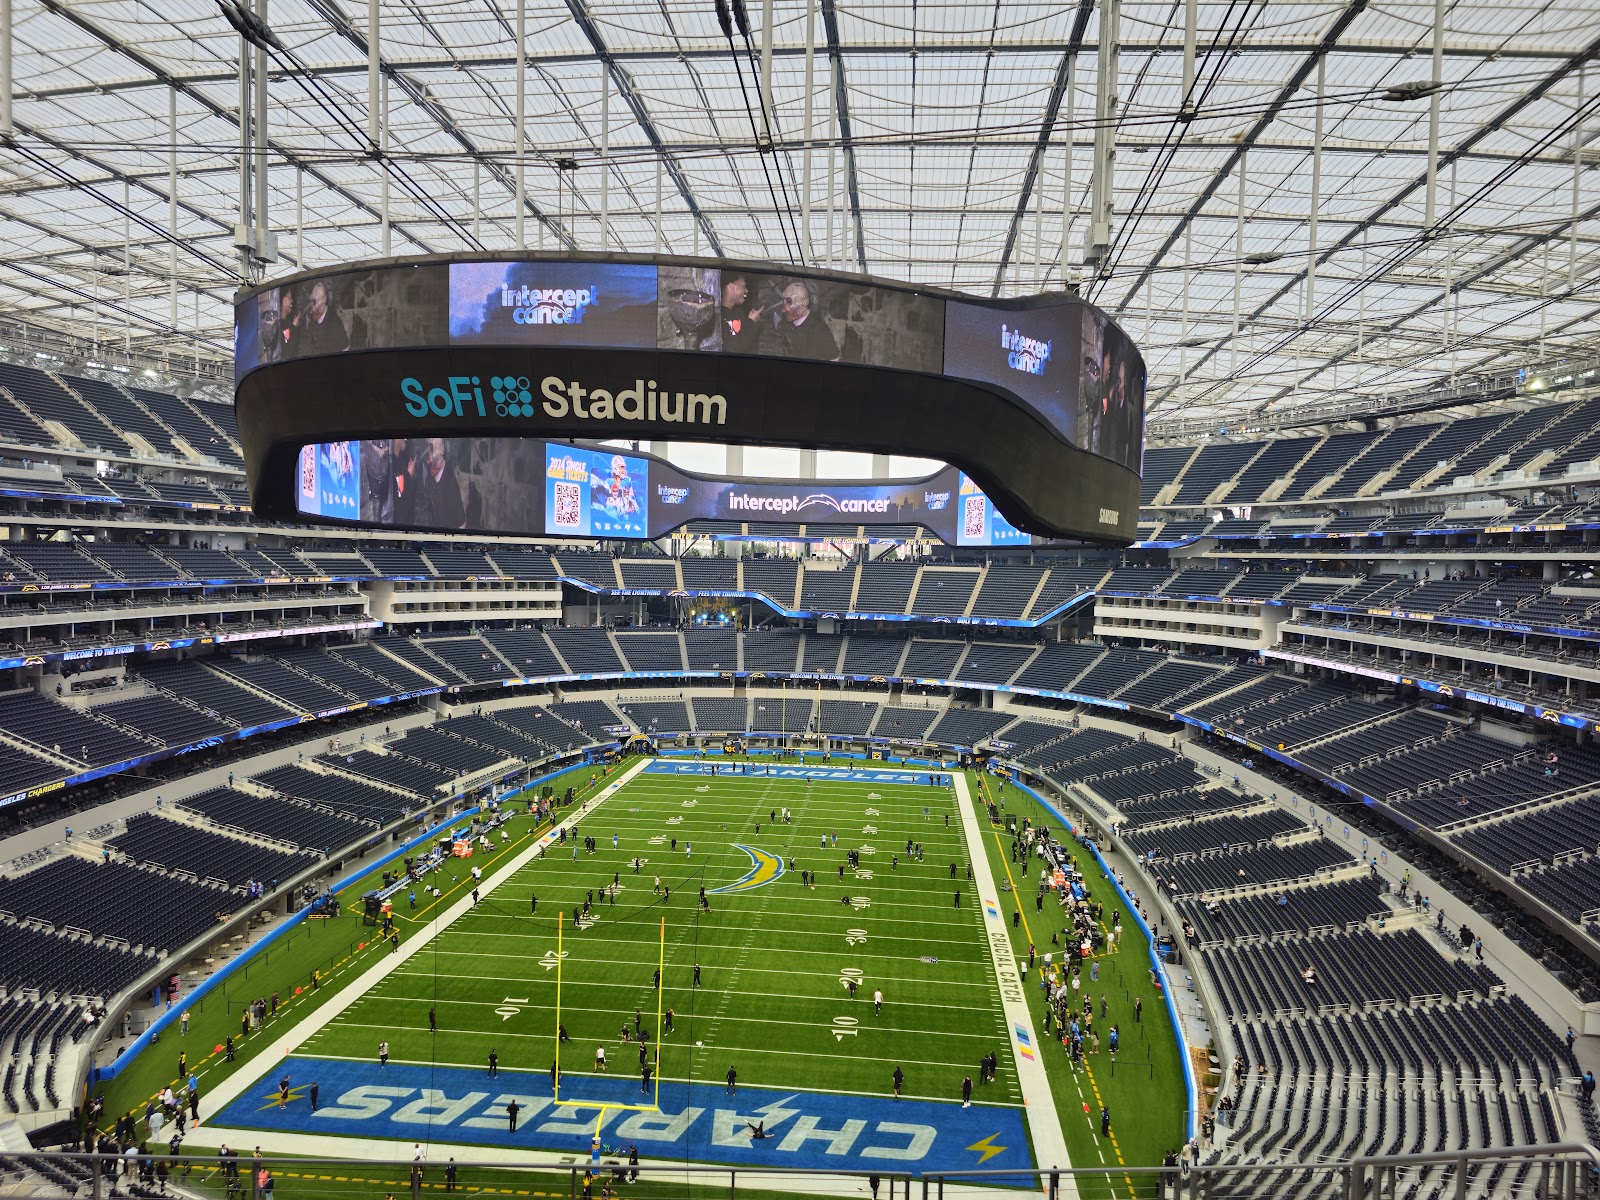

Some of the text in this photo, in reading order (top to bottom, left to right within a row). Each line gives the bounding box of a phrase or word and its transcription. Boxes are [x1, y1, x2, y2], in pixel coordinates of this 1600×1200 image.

[501, 283, 599, 309] intercept
[513, 307, 587, 324] cancer
[1001, 324, 1052, 361] intercept
[400, 375, 728, 425] SoFi Stadium
[729, 492, 891, 514] intercept cancer
[63, 645, 135, 661] WELCOME TO THE STORM
[1465, 691, 1525, 713] WELCOME TO THE STORM
[749, 768, 921, 781] ANGELES
[27, 780, 66, 798] CHARGERS
[845, 928, 868, 943] 30
[991, 932, 1023, 1003] CRUCIAL CATCH
[494, 996, 530, 1016] 10
[831, 1016, 859, 1037] 10
[310, 1084, 938, 1160] CHARGERS
